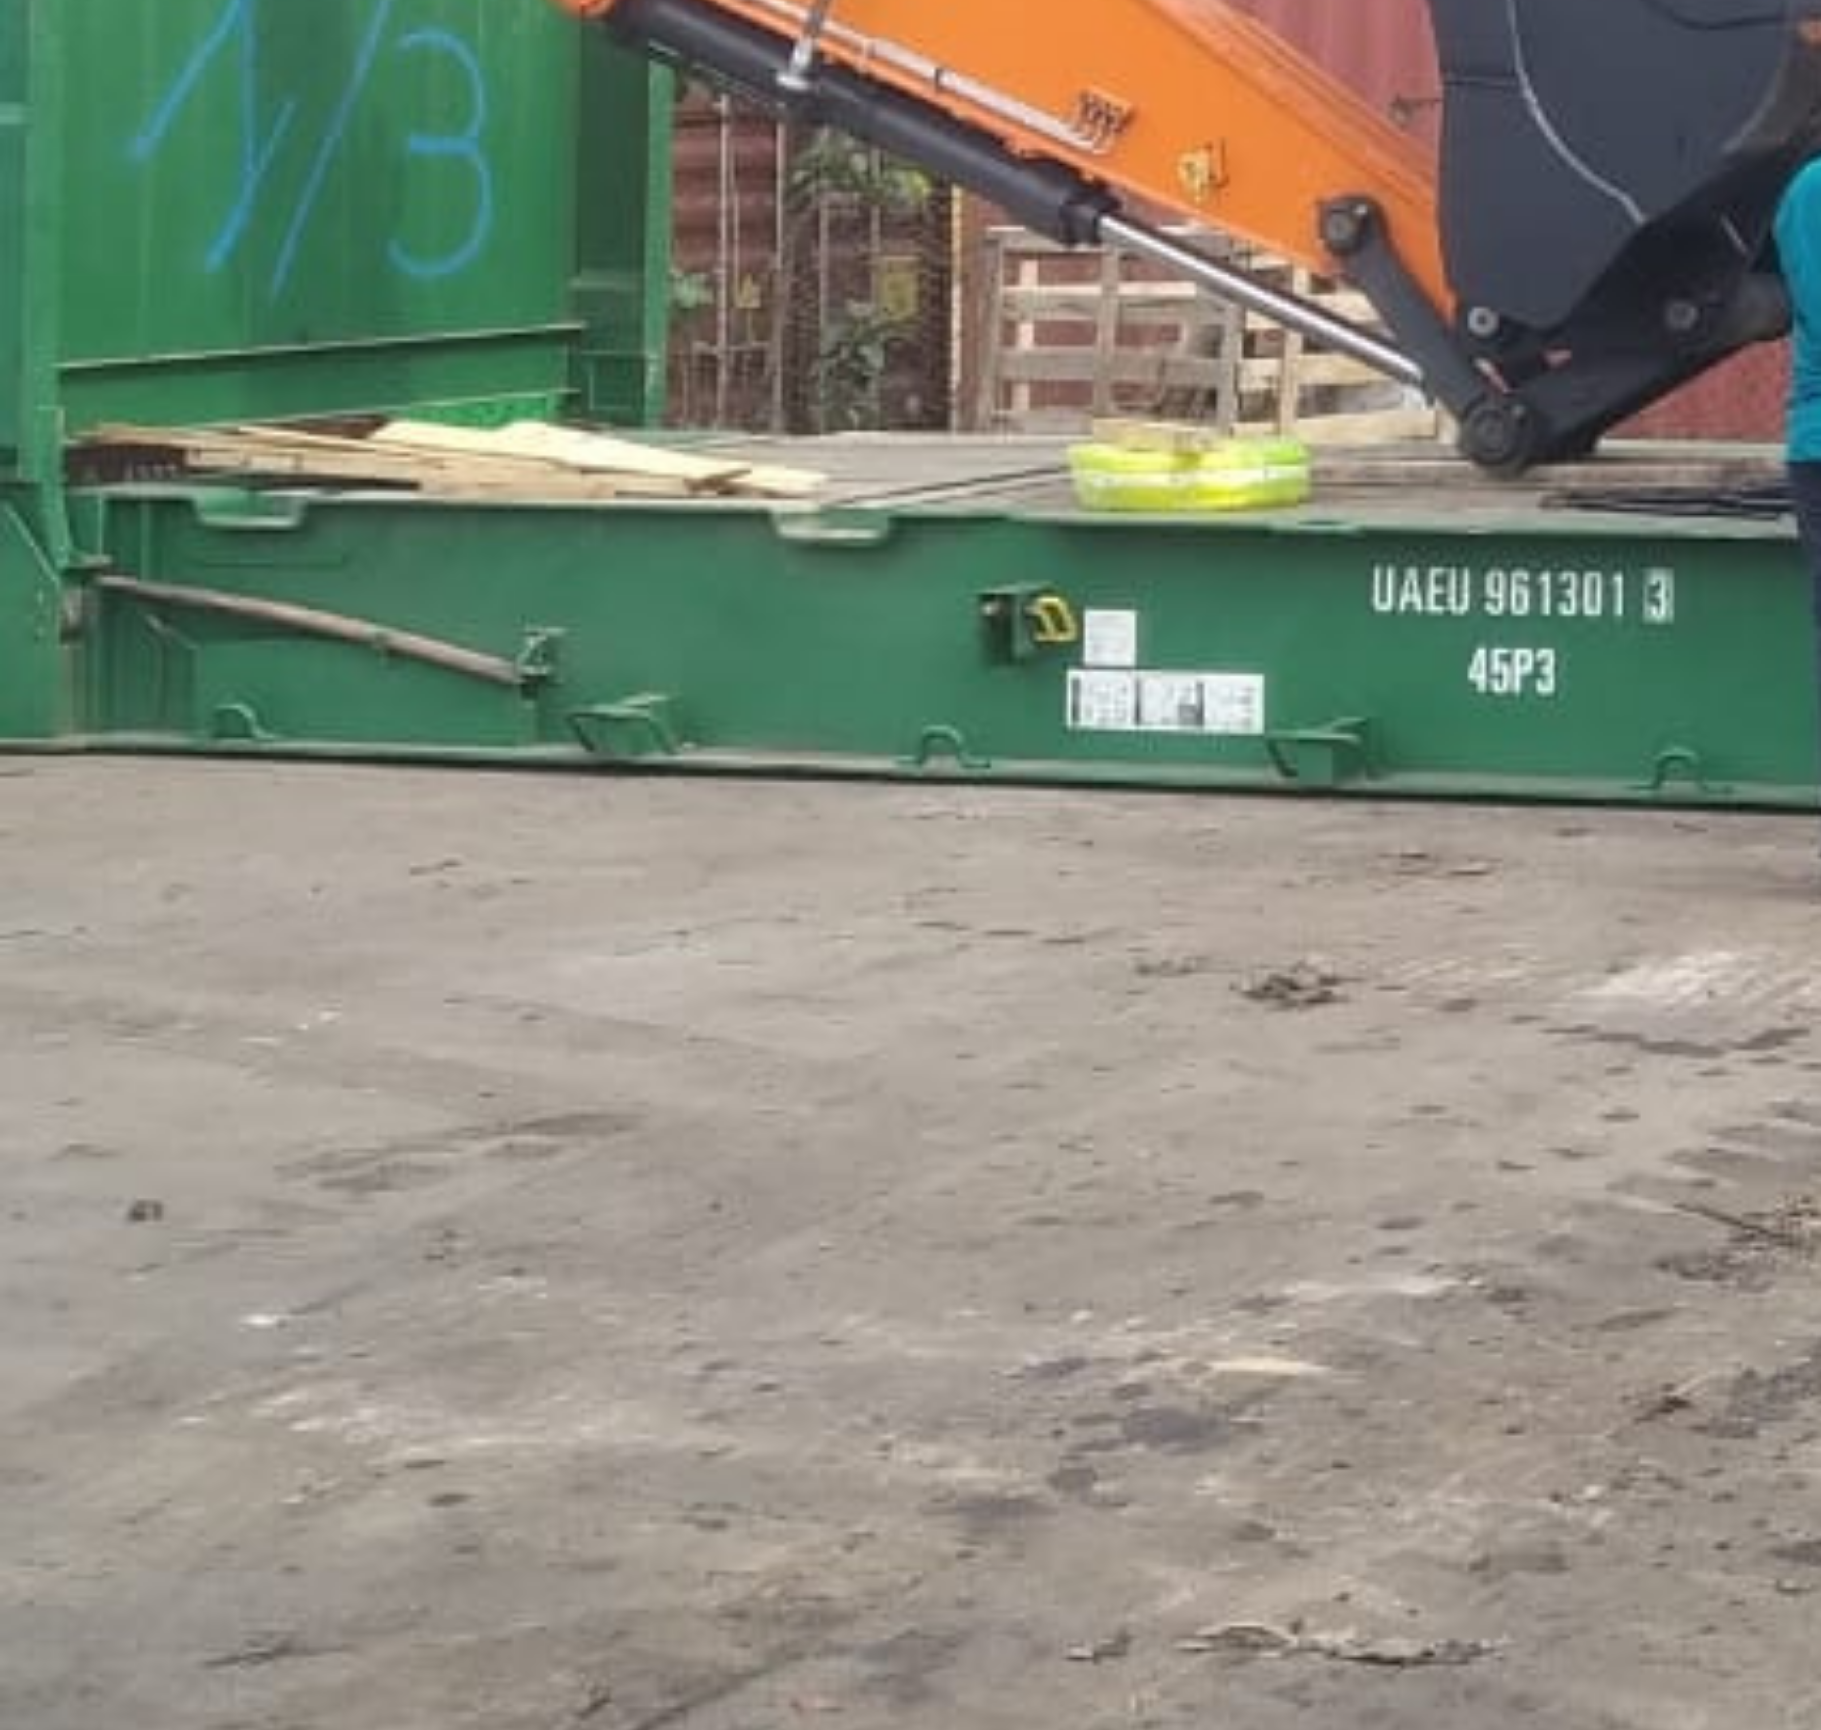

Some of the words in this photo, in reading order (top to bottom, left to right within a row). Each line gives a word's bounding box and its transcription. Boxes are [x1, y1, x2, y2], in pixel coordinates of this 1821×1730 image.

[1373, 567, 1470, 615] UAEU
[1484, 570, 1625, 619] 961301
[1644, 569, 1673, 622] 3
[1467, 647, 1557, 695] 45P3
